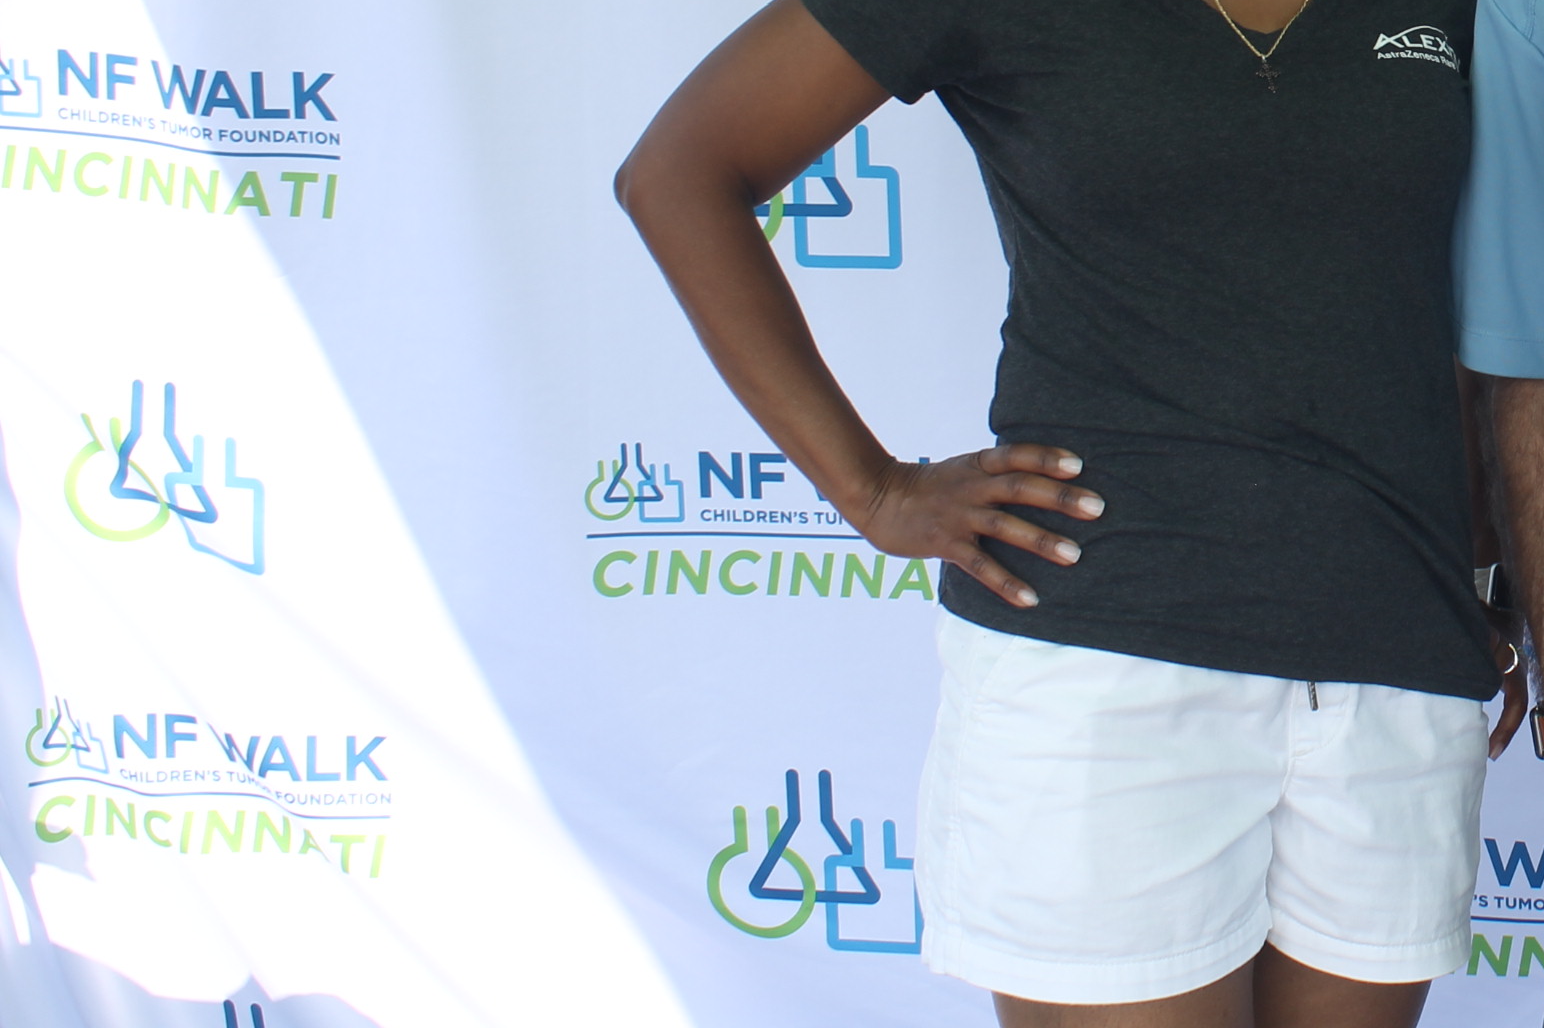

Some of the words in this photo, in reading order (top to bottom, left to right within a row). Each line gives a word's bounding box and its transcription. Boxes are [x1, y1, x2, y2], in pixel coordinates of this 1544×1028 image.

[1377, 49, 1440, 64] AstraZeneca
[57, 49, 138, 101] NF
[150, 59, 338, 121] WALK
[57, 107, 156, 130] CHILDREN'S
[160, 119, 213, 141] TUMOR
[218, 129, 341, 146] FOUNDATION
[0, 144, 339, 219] INCINNATI
[698, 451, 788, 500] NF
[700, 508, 809, 524] CHILDREN'S
[593, 549, 935, 601] CINCINNA
[113, 713, 198, 760] NF
[206, 720, 390, 782] WALK
[119, 768, 221, 784] CHILDREN'S
[274, 790, 392, 806] FOUNDATION
[35, 794, 386, 879] CINCINNATI
